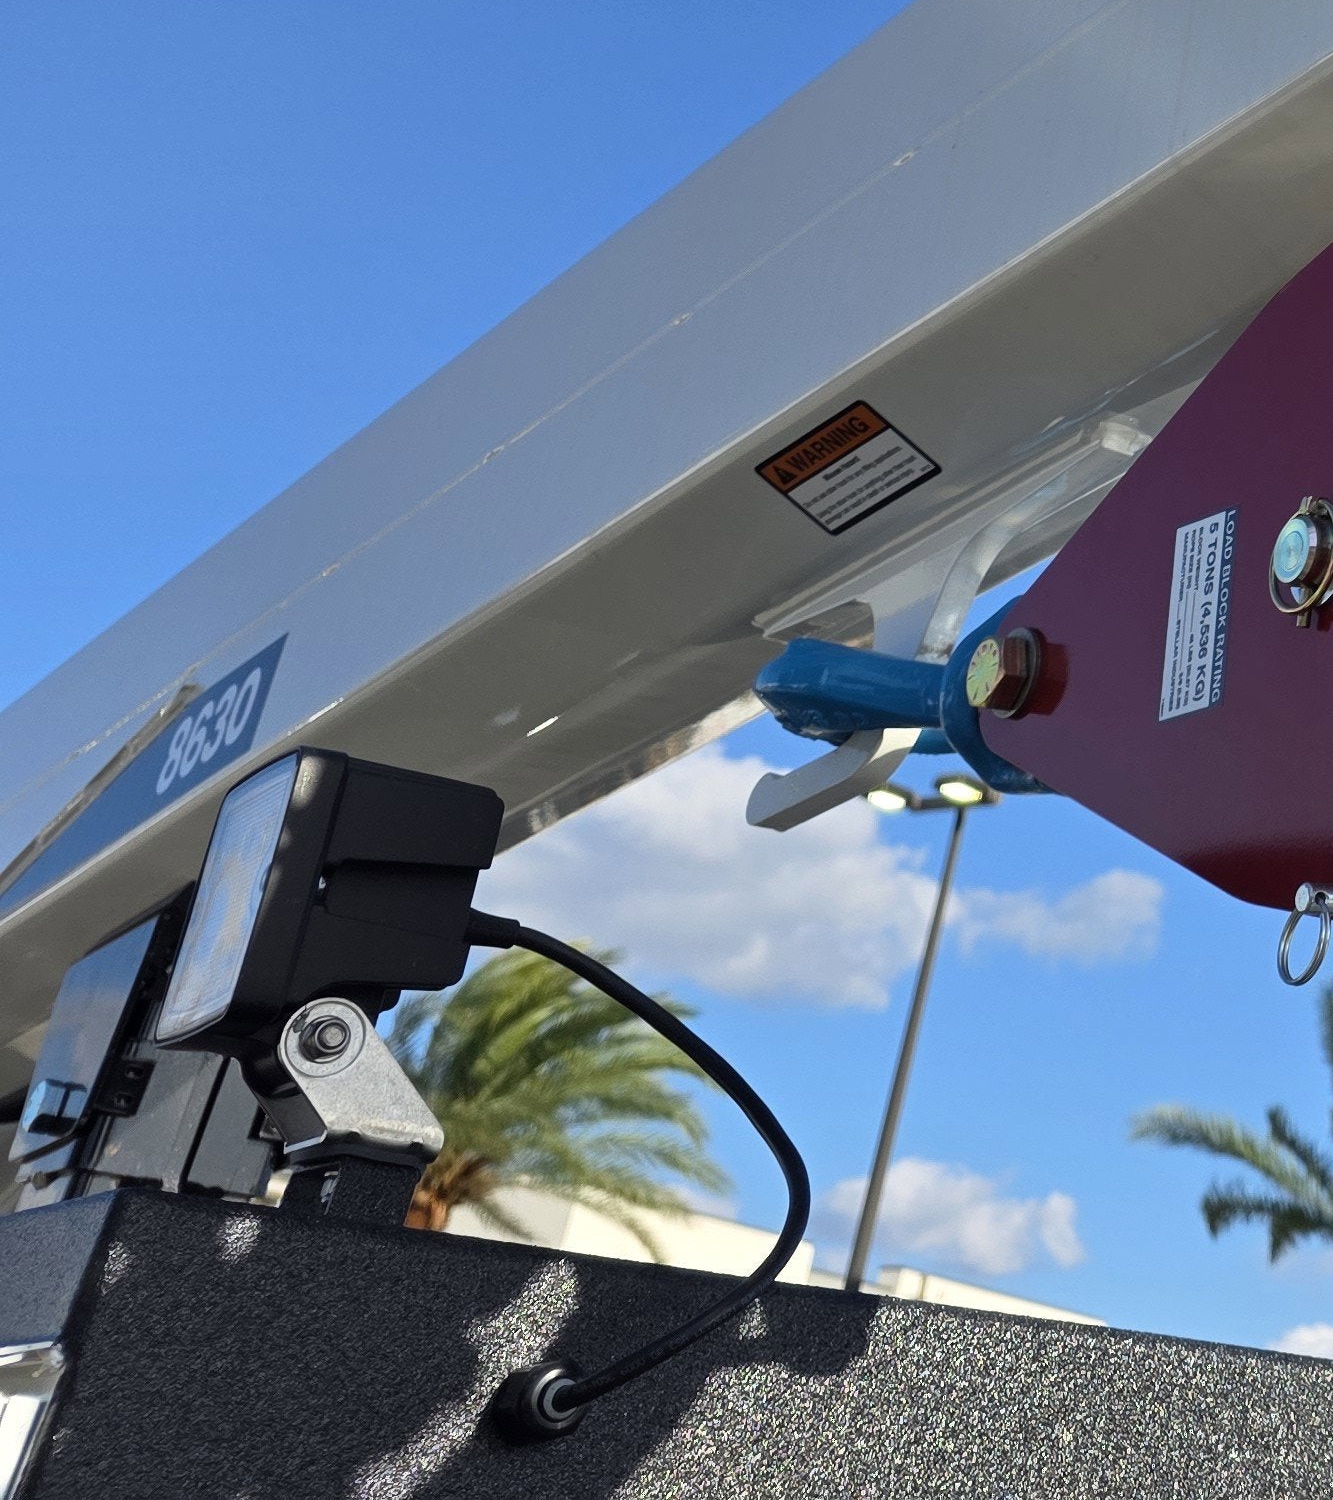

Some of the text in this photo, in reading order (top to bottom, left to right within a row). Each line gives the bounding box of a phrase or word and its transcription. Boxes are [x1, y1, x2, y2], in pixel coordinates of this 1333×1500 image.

[785, 415, 871, 473] WARNING
[1178, 532, 1189, 603] MANUFACTURER
[1193, 521, 1219, 702] 5 TONS (4,536 KG)
[1211, 509, 1236, 704] LOAD BLOCK RATING
[156, 666, 262, 795] 8630
[1168, 660, 1177, 712] INDUSTRIES
